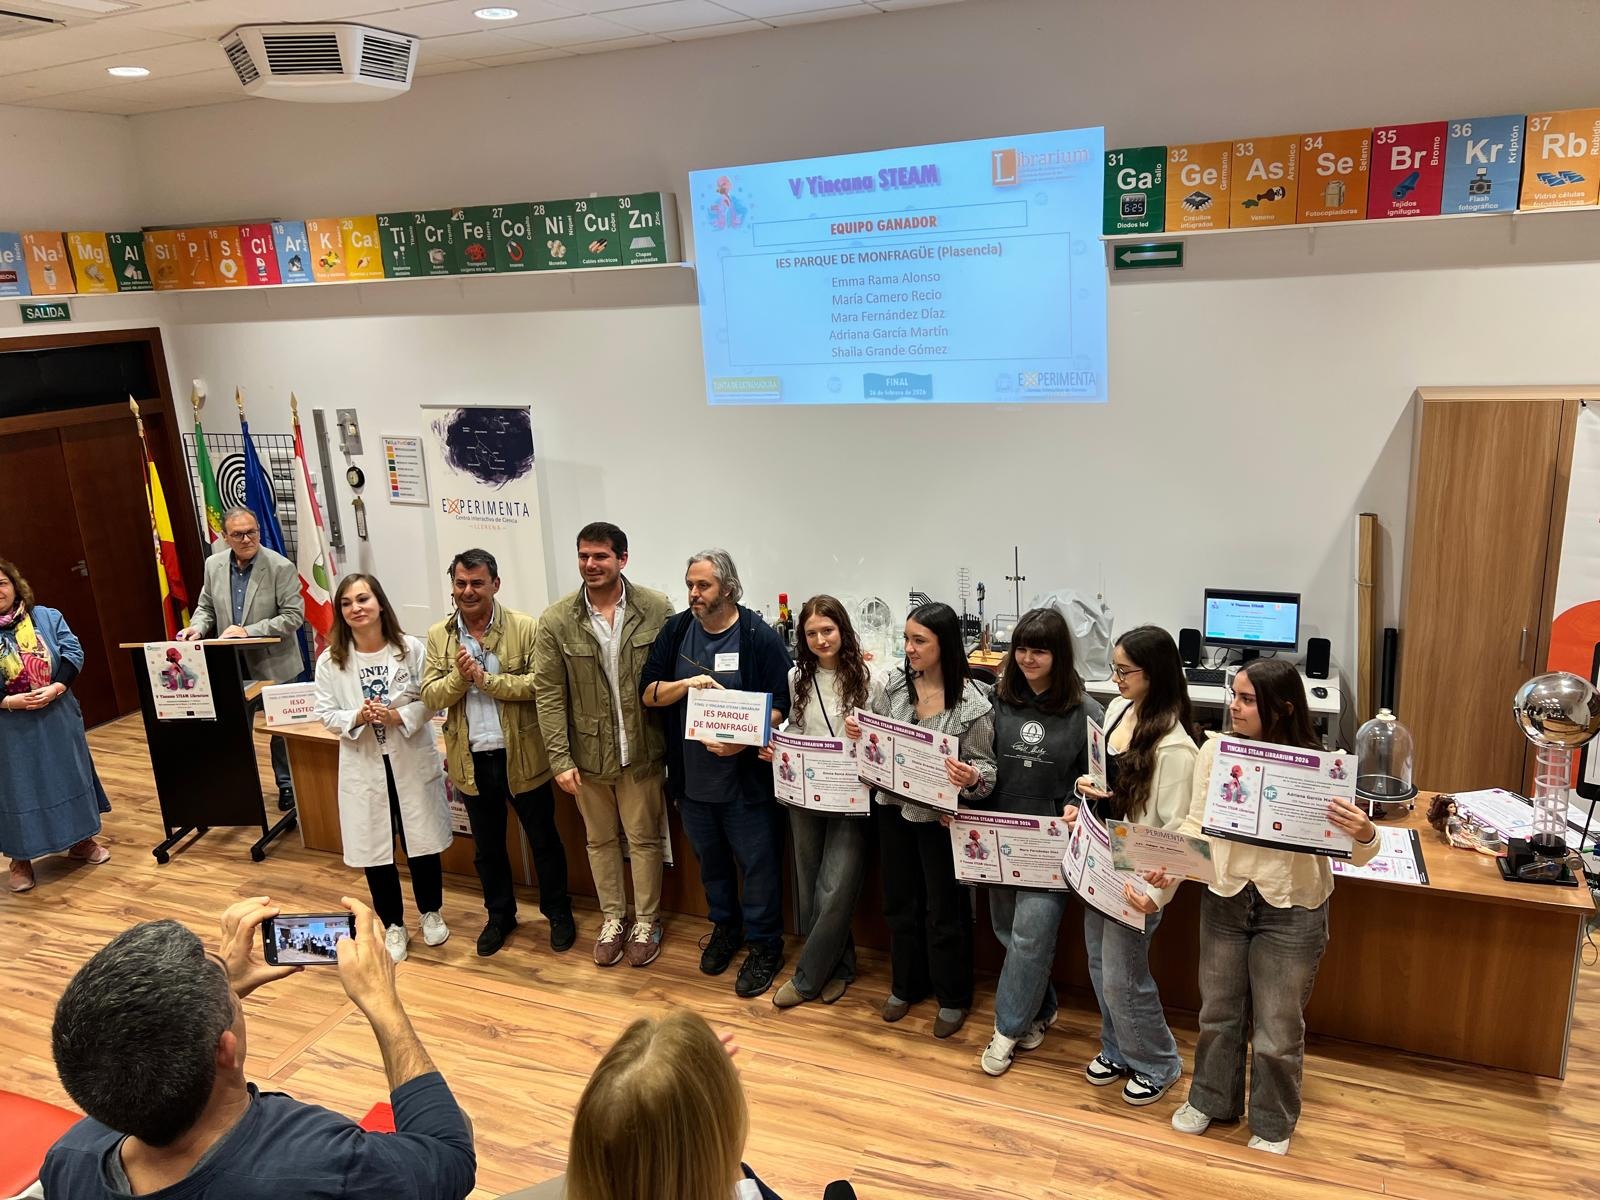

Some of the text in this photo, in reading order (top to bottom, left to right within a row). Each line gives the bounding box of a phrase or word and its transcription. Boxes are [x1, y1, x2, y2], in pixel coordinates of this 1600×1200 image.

[1452, 123, 1472, 137] 36
[1530, 117, 1552, 132] 37
[1304, 136, 1324, 151] 34
[1376, 130, 1397, 144] 35
[1508, 124, 1519, 164] Kriptón
[1236, 142, 1254, 156] 33
[1431, 136, 1440, 166] Bromo
[1466, 139, 1503, 165] Kr
[1542, 132, 1587, 159] Rb
[1108, 153, 1124, 166] 31
[1171, 149, 1187, 162] 32
[1359, 139, 1369, 171] Selenio
[1391, 146, 1427, 171] Br
[1220, 152, 1228, 191] Germanio
[1246, 159, 1284, 182] As
[1316, 152, 1354, 176] Se
[788, 164, 939, 199] V Yincana STEAM
[1117, 168, 1152, 190] Ga
[1154, 163, 1162, 185] Galio
[1180, 164, 1217, 187] Ge
[618, 197, 631, 209] 30
[1469, 195, 1489, 203] Flash
[1534, 190, 1585, 200] Vidrio células
[492, 207, 503, 218] 27
[533, 204, 545, 215] 28
[575, 201, 587, 212] 29
[1392, 200, 1417, 209] Tejidos
[1458, 202, 1498, 212] fotográfico
[308, 222, 318, 232] 19
[343, 220, 353, 230] 20
[378, 216, 389, 227] 22
[415, 214, 426, 224] 24
[545, 216, 564, 235] Ni
[584, 213, 610, 232] Cu
[628, 210, 652, 229] Zn
[831, 216, 937, 235] EQUIPO GANADOR
[1117, 221, 1139, 229] Diodos
[208, 230, 218, 239] 16
[241, 227, 250, 238] 17
[275, 224, 284, 235] 18
[389, 227, 405, 244] Ti
[425, 225, 443, 243] Cr
[463, 222, 484, 240] Fe
[501, 219, 525, 237] Co
[24, 234, 34, 244] 11
[110, 234, 122, 244] 13
[176, 232, 186, 241] 15
[286, 235, 301, 253] Ar
[320, 232, 333, 249] K
[351, 231, 372, 248] Ca
[32, 245, 58, 263] Na
[77, 244, 104, 264] Mg
[124, 246, 139, 261] Al
[155, 244, 170, 260] Si
[188, 242, 198, 258] P
[220, 240, 231, 256] S
[251, 238, 267, 255] Cl
[0, 249, 14, 263] e
[776, 242, 1003, 269] IES PARQUE DE MONFRAGÜE (Plasencia)
[832, 272, 941, 288] Emma Rama Alonso
[832, 289, 942, 305] María Camero Recio
[26, 307, 65, 319] SALIDA
[831, 307, 945, 323] Mara Fernández Díaz
[829, 324, 949, 341] Adriana García Martín
[865, 345, 906, 357] Grande
[908, 344, 948, 356] Gómez
[886, 377, 908, 387] FINAL
[1018, 370, 1097, 388] EXPERIMENTA
[442, 498, 530, 518] EXPERIMENTA
[471, 515, 495, 523] Interactivo
[290, 698, 305, 706] IESO
[703, 710, 750, 722] IES PARQUE
[693, 720, 758, 734] DE MONFRAGÜE
[880, 721, 893, 730] STEAM
[893, 725, 916, 737] LIBRARIUM
[790, 738, 802, 746] STEAM
[802, 741, 824, 749] LIBRARIUM
[1227, 744, 1310, 764] YINCANA STEAM LIBRARIUM 2026
[995, 818, 1019, 826] LIBRARIUM
